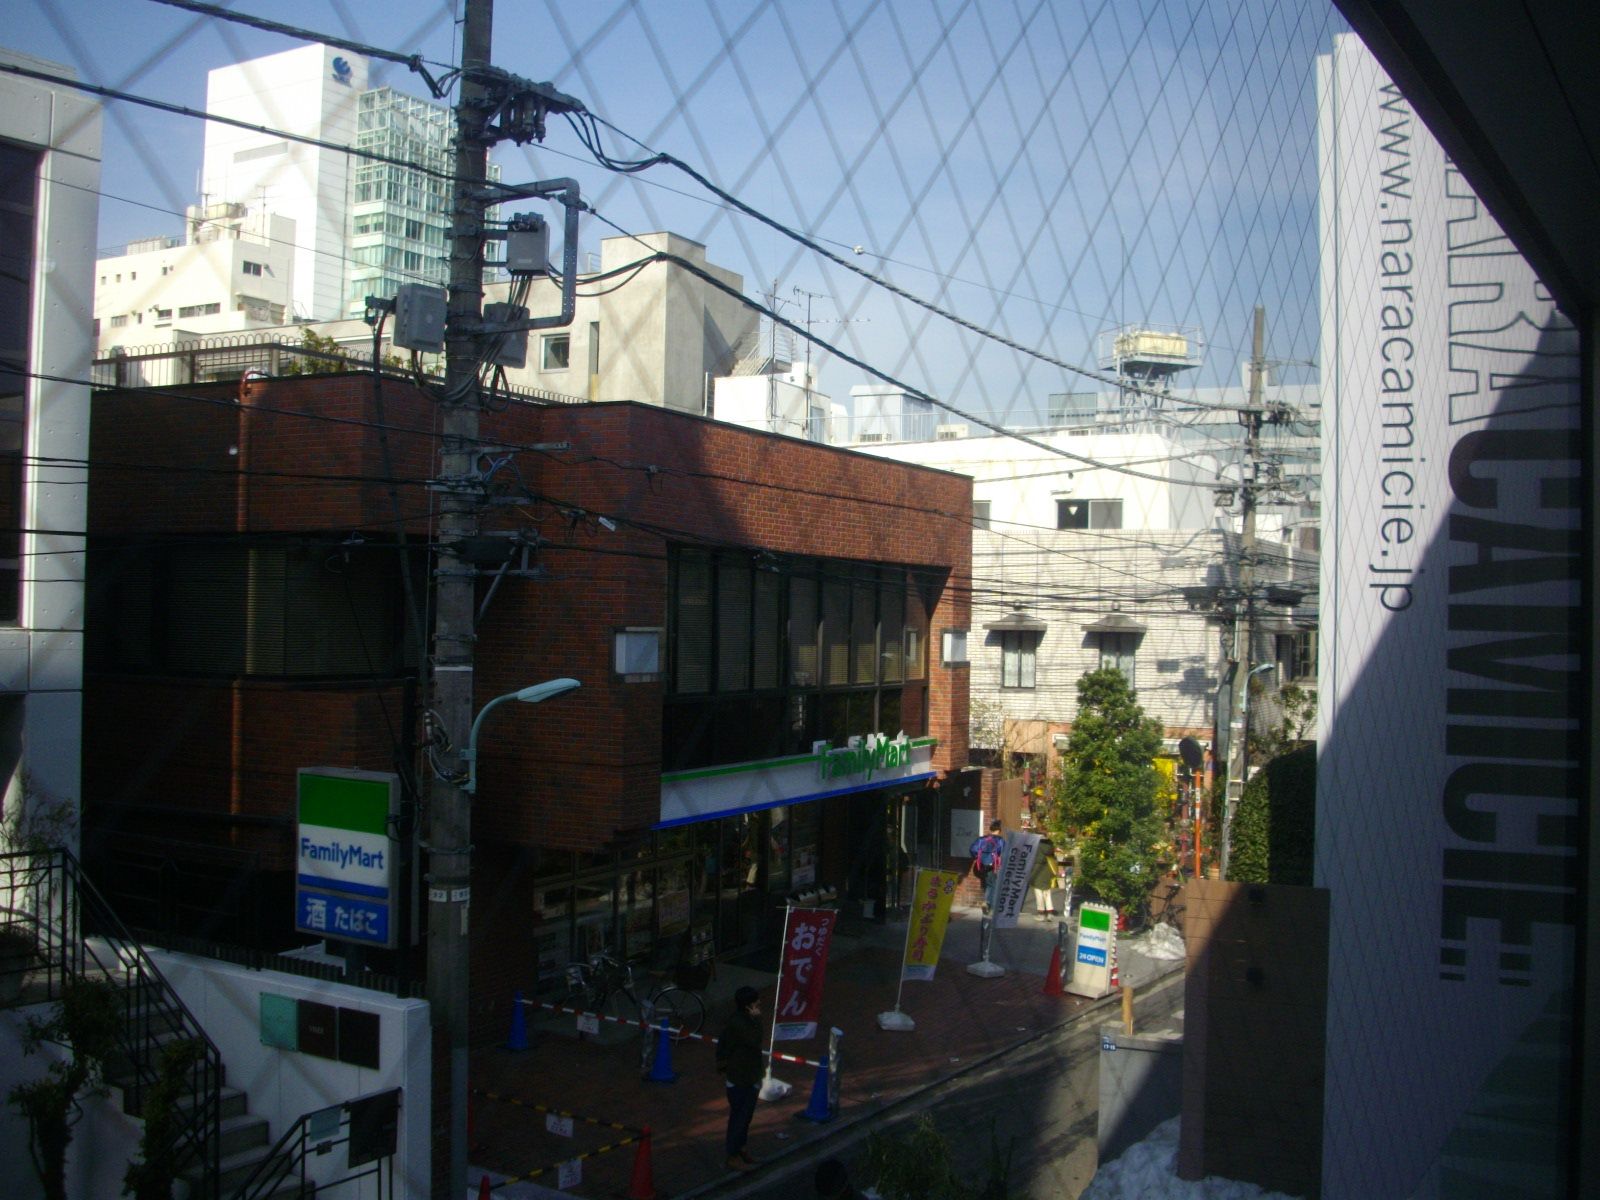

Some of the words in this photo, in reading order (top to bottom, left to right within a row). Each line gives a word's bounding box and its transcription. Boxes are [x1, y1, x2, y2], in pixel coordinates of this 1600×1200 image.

[813, 730, 910, 781] FamilyMart
[300, 837, 384, 869] FamilyMart
[998, 847, 1018, 913] collection
[1007, 844, 1033, 918] FamilyMart
[305, 897, 327, 930] 酒
[334, 905, 378, 935] たばこ
[780, 922, 817, 1017] おでん
